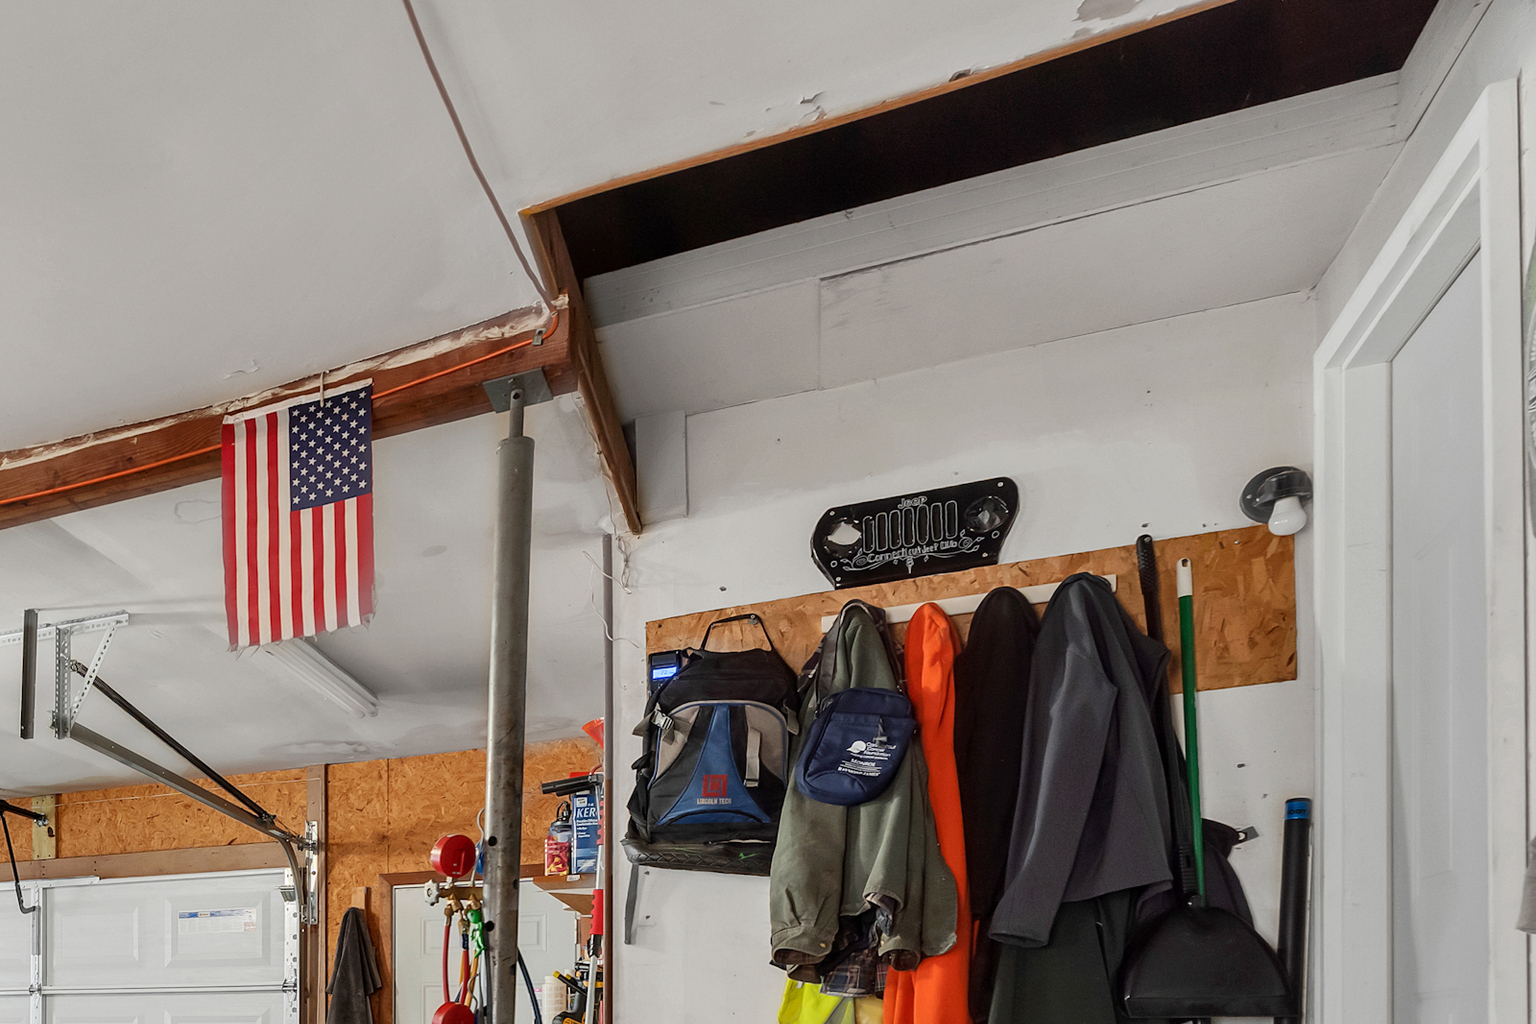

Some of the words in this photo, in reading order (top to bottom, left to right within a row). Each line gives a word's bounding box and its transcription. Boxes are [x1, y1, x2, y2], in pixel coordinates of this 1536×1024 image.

[696, 797, 718, 805] LINCOLN
[718, 797, 732, 805] TECH
[576, 807, 597, 818] KER
